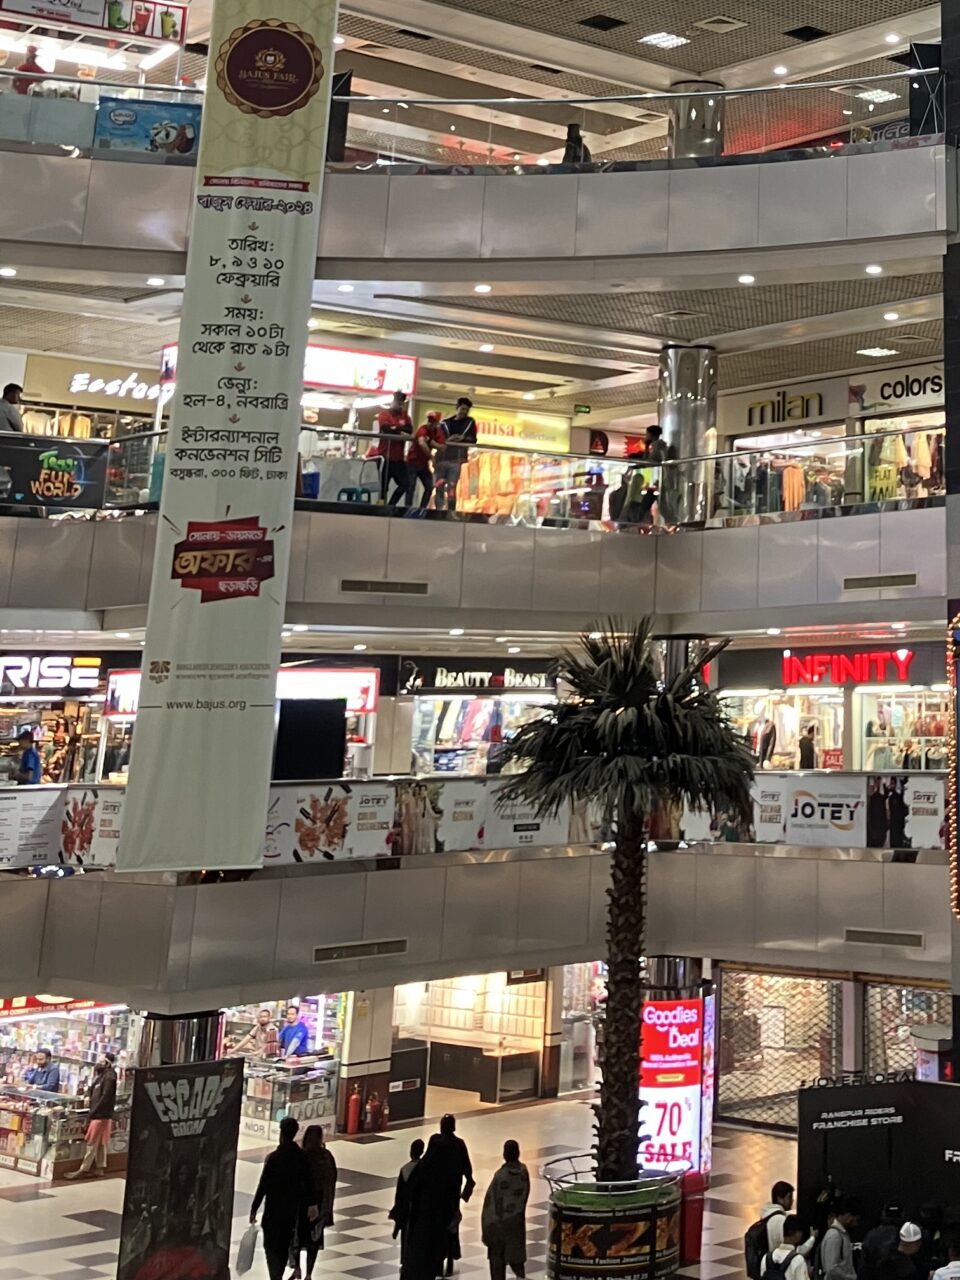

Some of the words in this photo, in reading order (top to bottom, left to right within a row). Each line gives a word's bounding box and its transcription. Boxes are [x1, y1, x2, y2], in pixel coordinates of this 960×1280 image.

[239, 69, 271, 80] BAJUS
[274, 72, 298, 83] FAIR
[197, 194, 234, 212] বাজুস
[228, 235, 274, 252] তারিখ:
[232, 256, 242, 267] ৯
[247, 258, 257, 268] ও
[263, 259, 284, 269] ১০
[217, 271, 280, 288] ফেব্রুয়ারি
[224, 306, 263, 321] সময়:
[201, 323, 241, 337] সকাল
[192, 341, 226, 354] থেকে
[230, 342, 257, 355] রাত
[218, 376, 257, 393] ভেন্যু:
[880, 374, 942, 400] colors
[236, 393, 288, 410] নবরাত্রি
[748, 391, 823, 427] milan
[182, 426, 279, 444] ইন্টারন্যাশনাল
[175, 448, 249, 462] কনভেনশন
[254, 446, 282, 464] সিটি
[39, 470, 76, 483] FUN
[211, 469, 235, 478] ৩০০
[266, 470, 288, 480] ঢাকা
[31, 481, 81, 497] WORLD
[174, 548, 256, 575] অফার
[0, 657, 101, 693] RISE
[782, 648, 914, 685] INFINITY
[435, 668, 492, 688] BEAUTY
[504, 668, 548, 688] BEAST
[167, 699, 246, 711] www.bajus.org
[826, 755, 843, 765] SALE
[791, 799, 859, 820] JOTEY
[643, 1006, 698, 1024] Goodies
[669, 1028, 699, 1048] Deal
[144, 1076, 235, 1121] ESCAPE
[655, 1102, 682, 1137] 70
[812, 1119, 868, 1130] FRANCHISE
[871, 1116, 903, 1125] STORE
[645, 1141, 693, 1163] SALE
